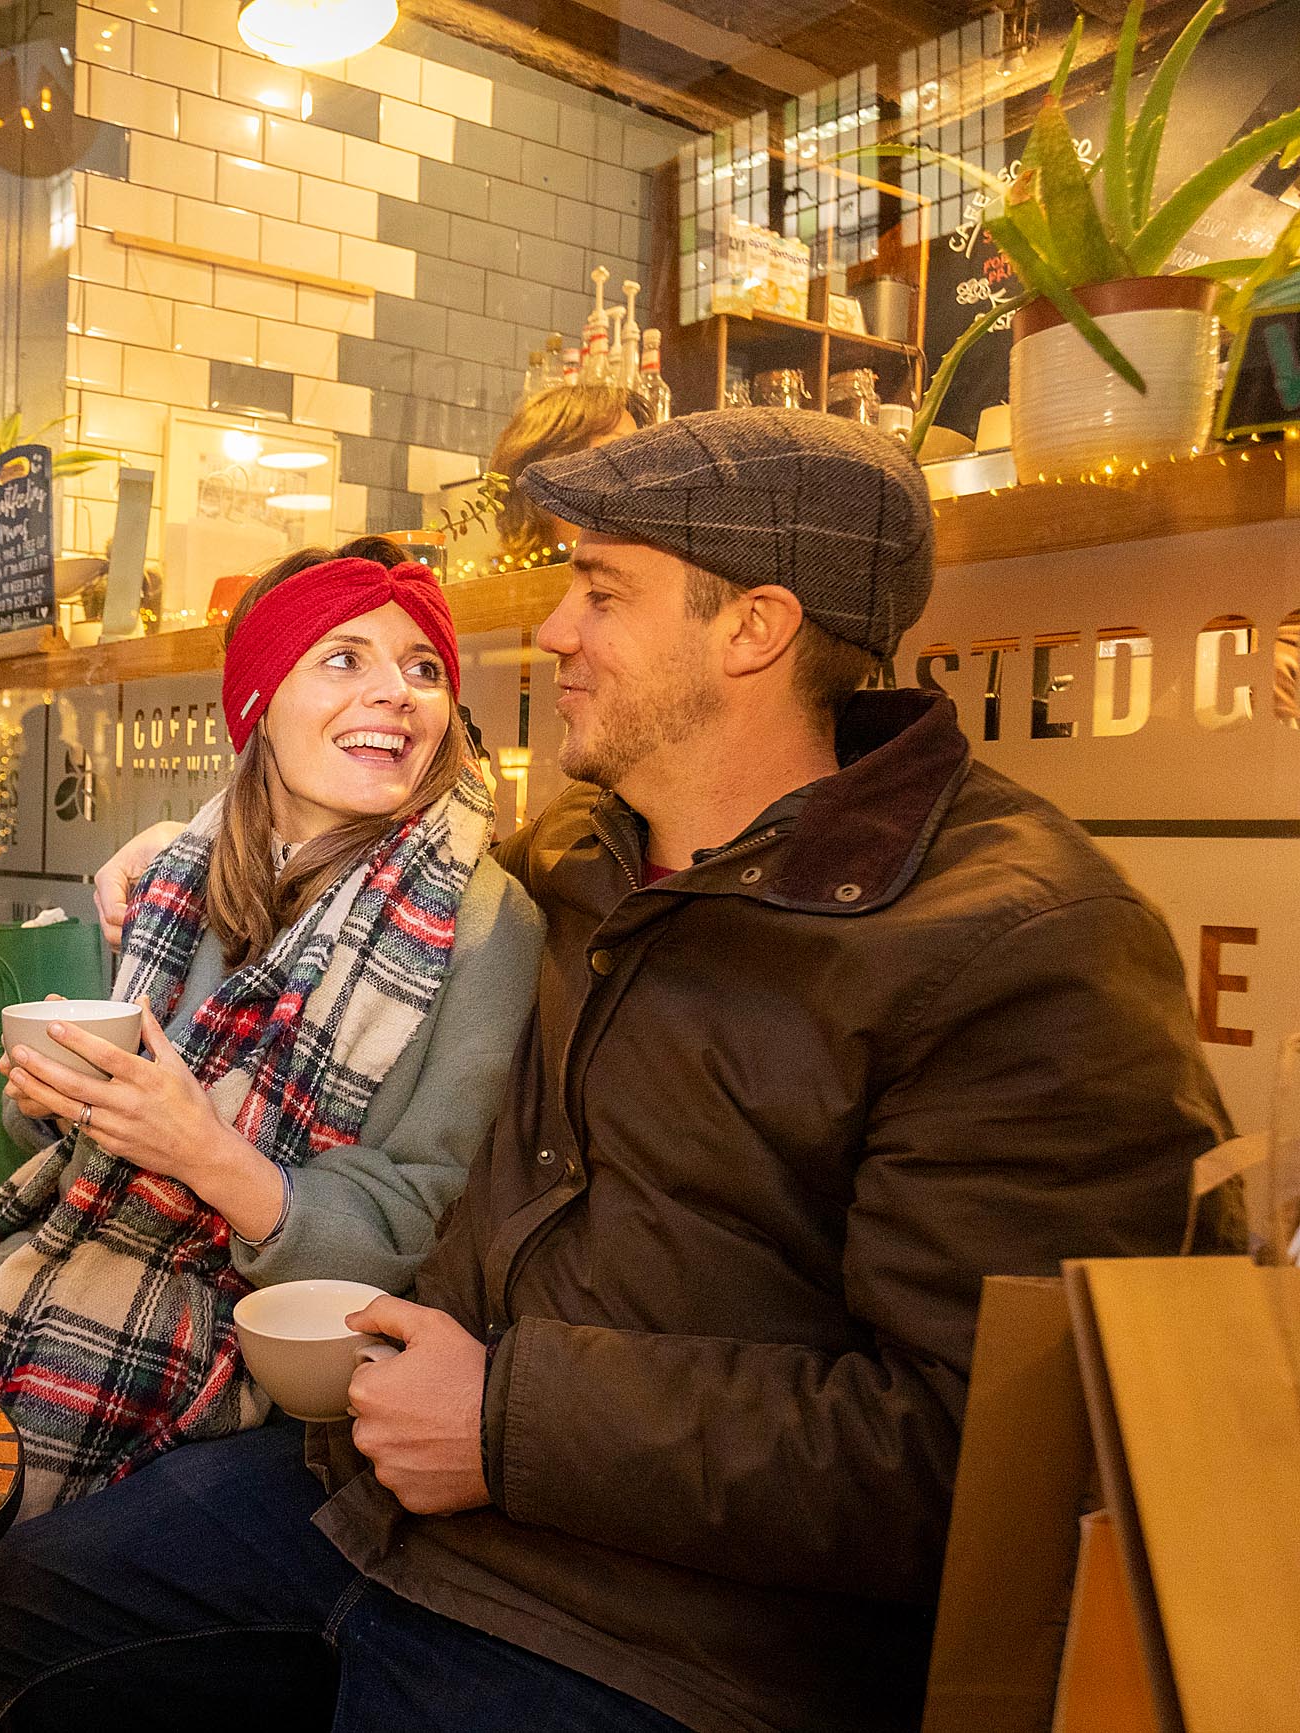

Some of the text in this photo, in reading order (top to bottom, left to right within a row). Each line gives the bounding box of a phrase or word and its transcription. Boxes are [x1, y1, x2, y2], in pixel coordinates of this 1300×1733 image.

[133, 702, 232, 751] COFFE
[866, 624, 1154, 742] STED
[1200, 925, 1257, 1047] E
